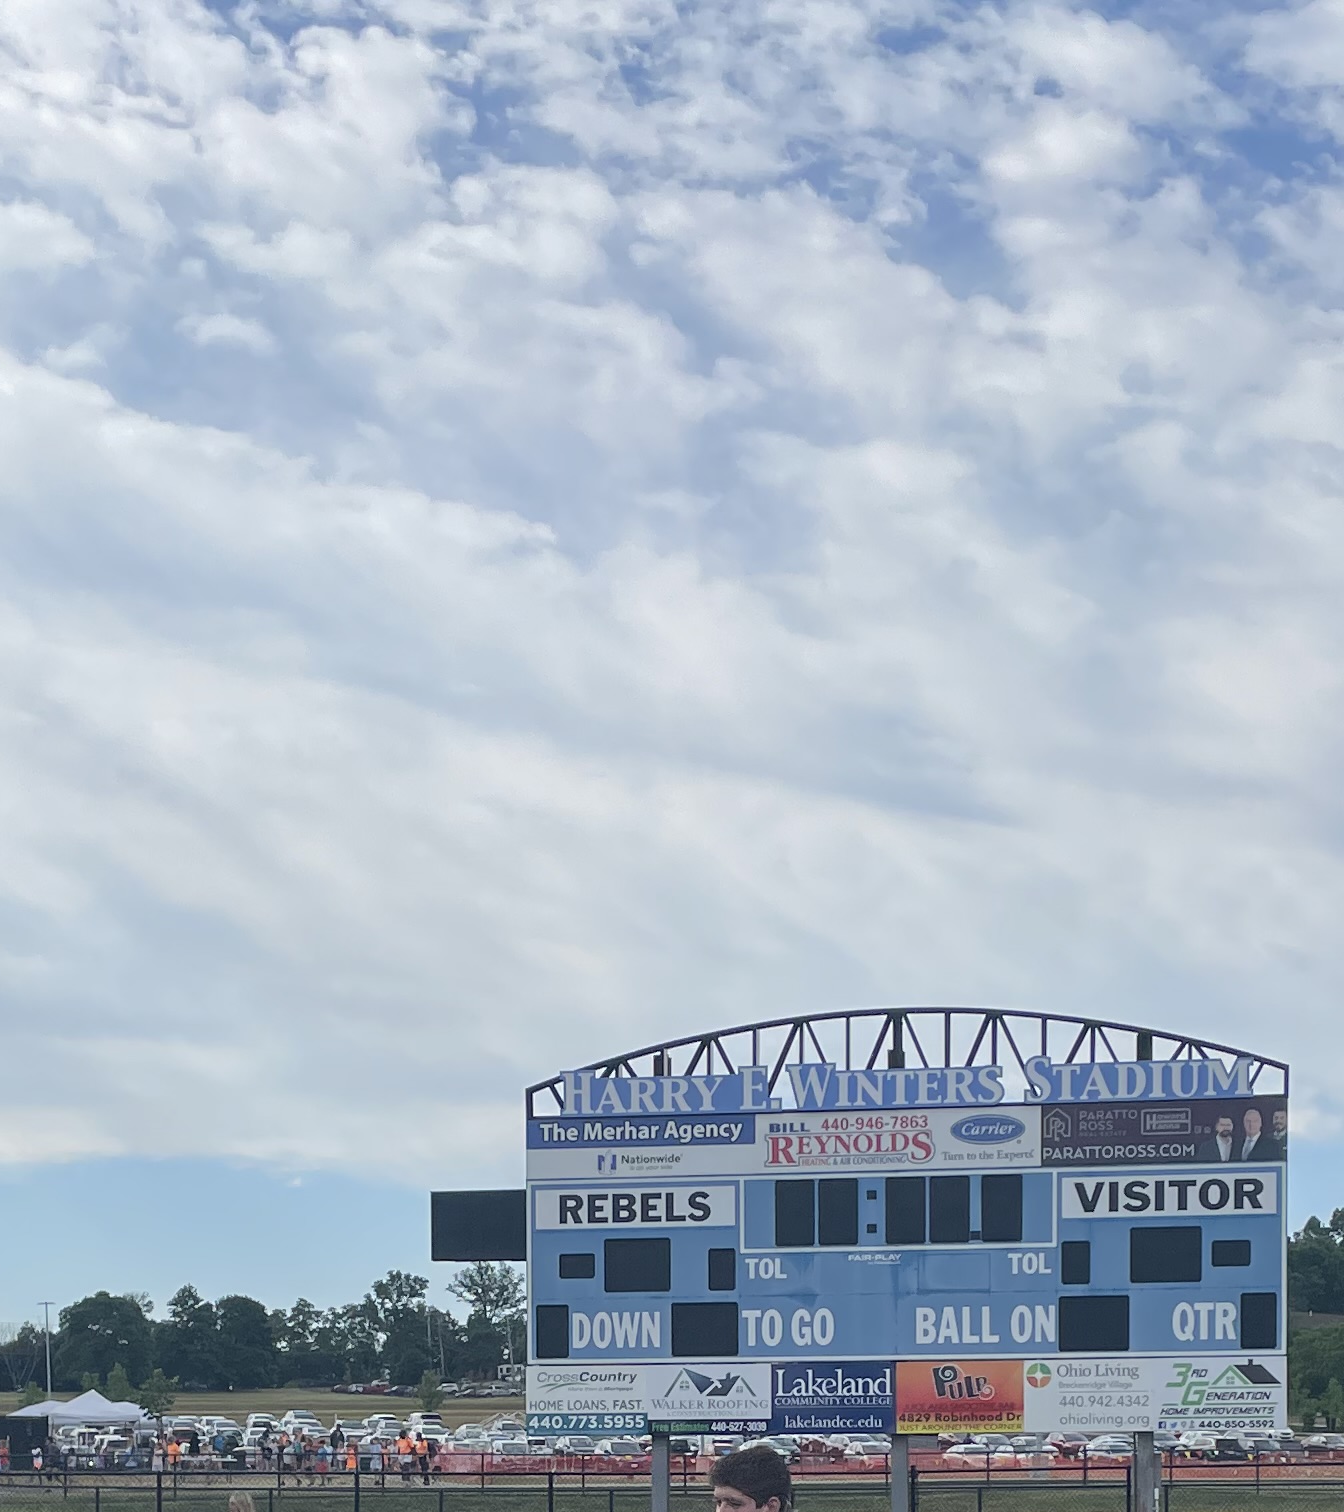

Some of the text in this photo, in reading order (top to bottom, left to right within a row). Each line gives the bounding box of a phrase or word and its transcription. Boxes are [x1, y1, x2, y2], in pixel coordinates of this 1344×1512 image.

[563, 1056, 1254, 1115] HARRY E. WINTERS STADIUM
[1079, 1109, 1138, 1121] PARATTO
[539, 1120, 743, 1143] The Merhar Agency
[769, 1114, 929, 1133] BILL 440-946-7863
[960, 1121, 1016, 1136] Carrier
[1079, 1120, 1114, 1131] ROSS
[767, 1131, 934, 1165] REYNOLDS
[942, 1151, 965, 1160] Turn
[966, 1151, 977, 1160] to
[978, 1150, 994, 1160] the
[1042, 1143, 1195, 1160] PARATTOROSS.COM
[621, 1153, 681, 1165] Nationwide
[801, 1157, 831, 1166] HEATING
[840, 1156, 851, 1165] AIR
[853, 1155, 907, 1165] CONDITIONING
[1074, 1178, 1264, 1213] VISITOR
[558, 1191, 712, 1225] REBELS
[744, 1257, 788, 1280] TOL
[1007, 1252, 1052, 1275] TOL
[741, 1307, 836, 1347] TO GO
[914, 1304, 1056, 1345] BALL ON
[1171, 1301, 1237, 1342] QTR
[571, 1311, 662, 1350] DOWN
[1056, 1363, 1140, 1380] Ohio Living
[775, 1368, 893, 1397] Lakeland
[1108, 1381, 1133, 1390] Village
[774, 1397, 891, 1406] COMMUNITY COLLEGE
[1058, 1395, 1150, 1408] 440.942.4342
[1181, 1381, 1272, 1406] GENERATION
[528, 1399, 645, 1412] HOME LOANS, FAST.
[651, 1399, 769, 1410] WALKER ROOFING
[1159, 1406, 1275, 1415] HOME IMPROVEMENTS
[528, 1415, 645, 1429] 440.773.5955
[784, 1414, 883, 1430] lakelandcc.edu
[898, 1412, 1022, 1423] 4829 Robinhood Dr
[1059, 1412, 1150, 1428] ohioliving.org
[1198, 1420, 1275, 1429] 440-850-5592
[651, 1422, 669, 1432] Free
[670, 1421, 709, 1432] Estimates
[899, 1423, 1023, 1431] JUST AROUND THE CORNER
